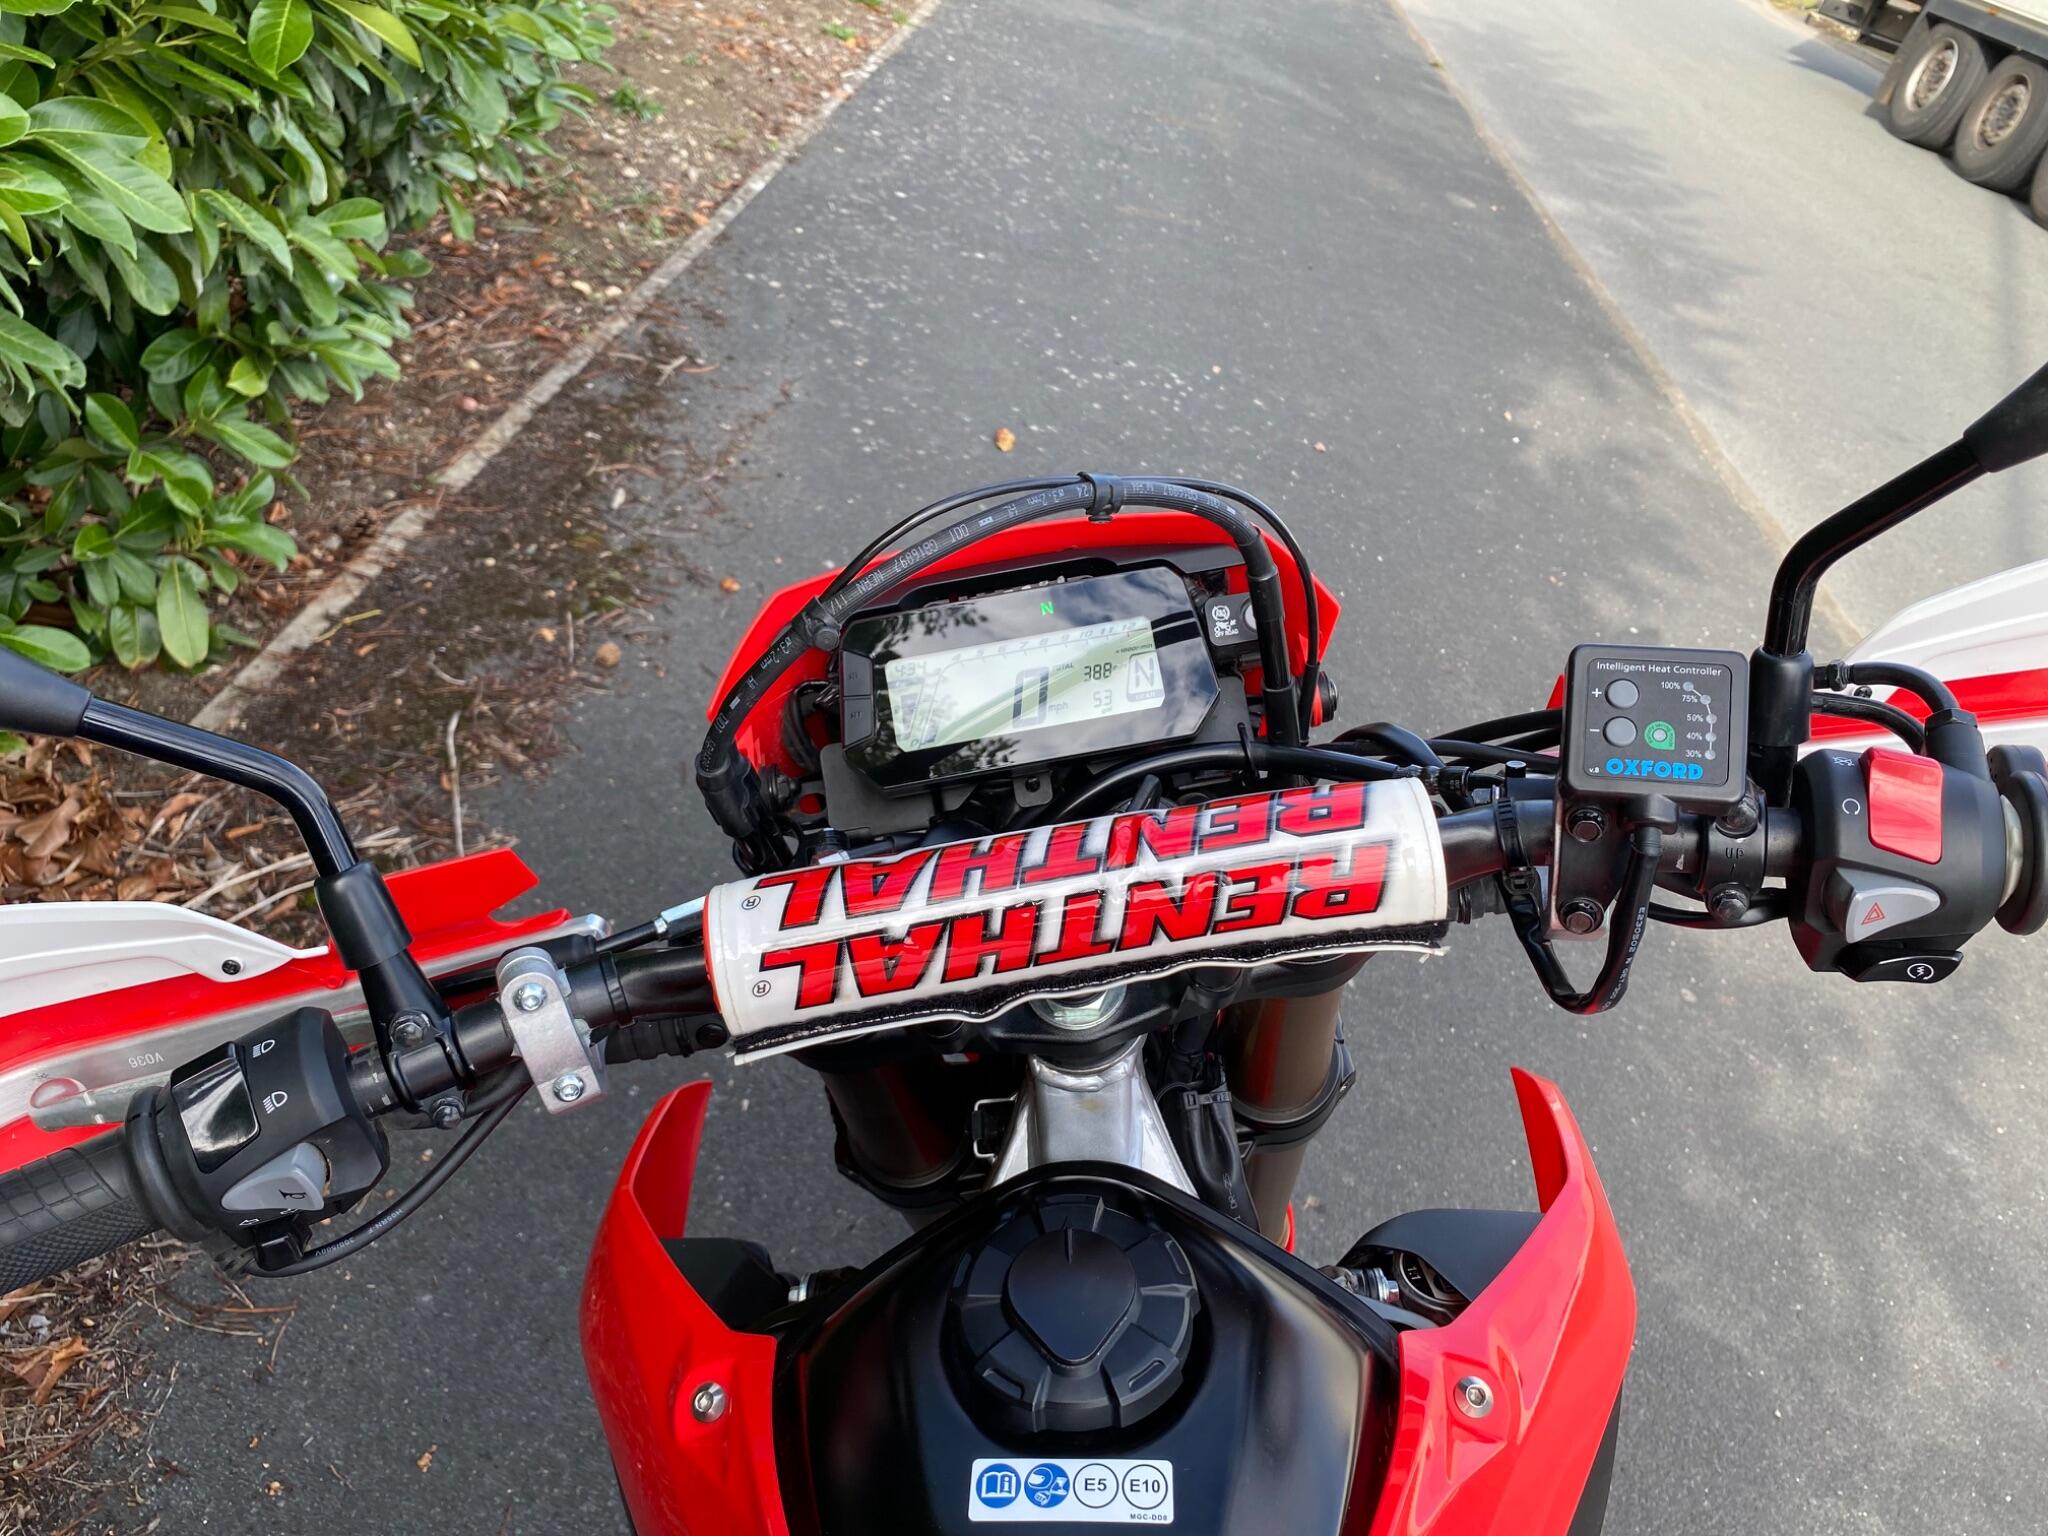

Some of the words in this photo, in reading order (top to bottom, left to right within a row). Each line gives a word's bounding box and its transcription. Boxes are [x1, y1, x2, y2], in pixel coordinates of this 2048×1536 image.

[1040, 601, 1054, 616] N
[1083, 662, 1112, 682] 388
[1135, 657, 1155, 688] N
[1597, 661, 1646, 673] Intelligent
[1648, 664, 1671, 674] Heat
[1673, 666, 1722, 677] Controller
[1661, 681, 1681, 690] 100%
[1682, 694, 1698, 703] 75%
[1048, 702, 1068, 715] mph
[1686, 714, 1704, 723] 50%
[1686, 732, 1703, 741] 40%
[1685, 749, 1702, 759] 30%
[1605, 757, 1704, 781] OXFORD
[756, 781, 1367, 931] RENTHAL
[1725, 847, 1744, 859] UP
[761, 842, 1395, 1012] RENTHAL
[1084, 1478, 1107, 1492] E5
[1130, 1479, 1161, 1494] E10
